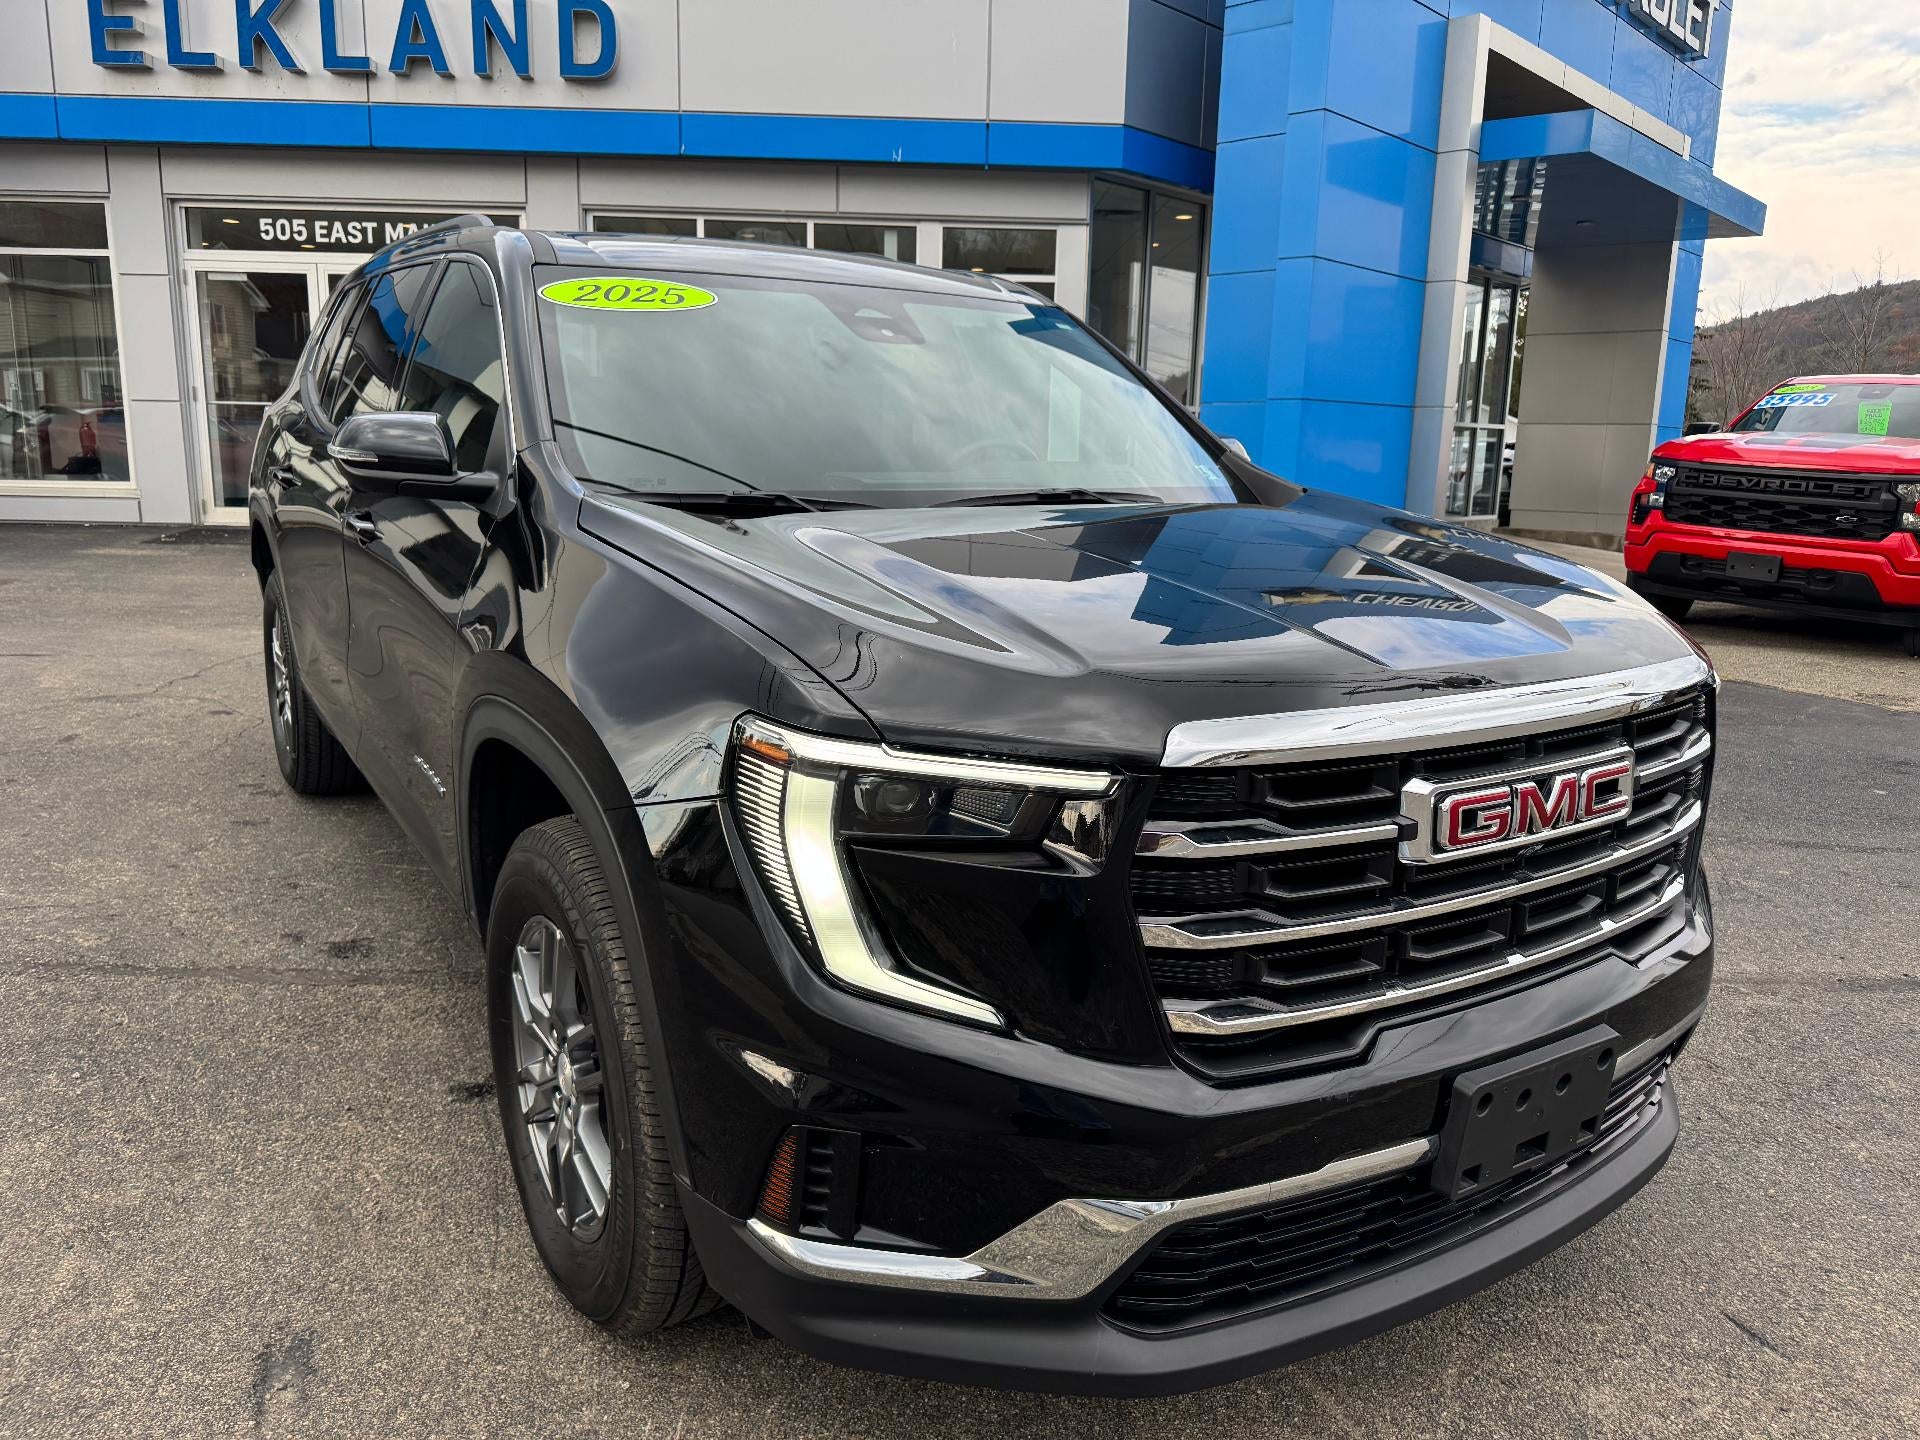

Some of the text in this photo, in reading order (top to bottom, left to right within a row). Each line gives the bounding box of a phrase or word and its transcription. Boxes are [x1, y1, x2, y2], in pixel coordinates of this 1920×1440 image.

[87, 0, 617, 78] ELKLAND
[258, 217, 437, 245] 505 EAST MA
[572, 284, 689, 305] 2025
[1757, 393, 1833, 408] 35995
[1680, 472, 1881, 497] CHEVROLET
[1438, 760, 1631, 849] GMC
